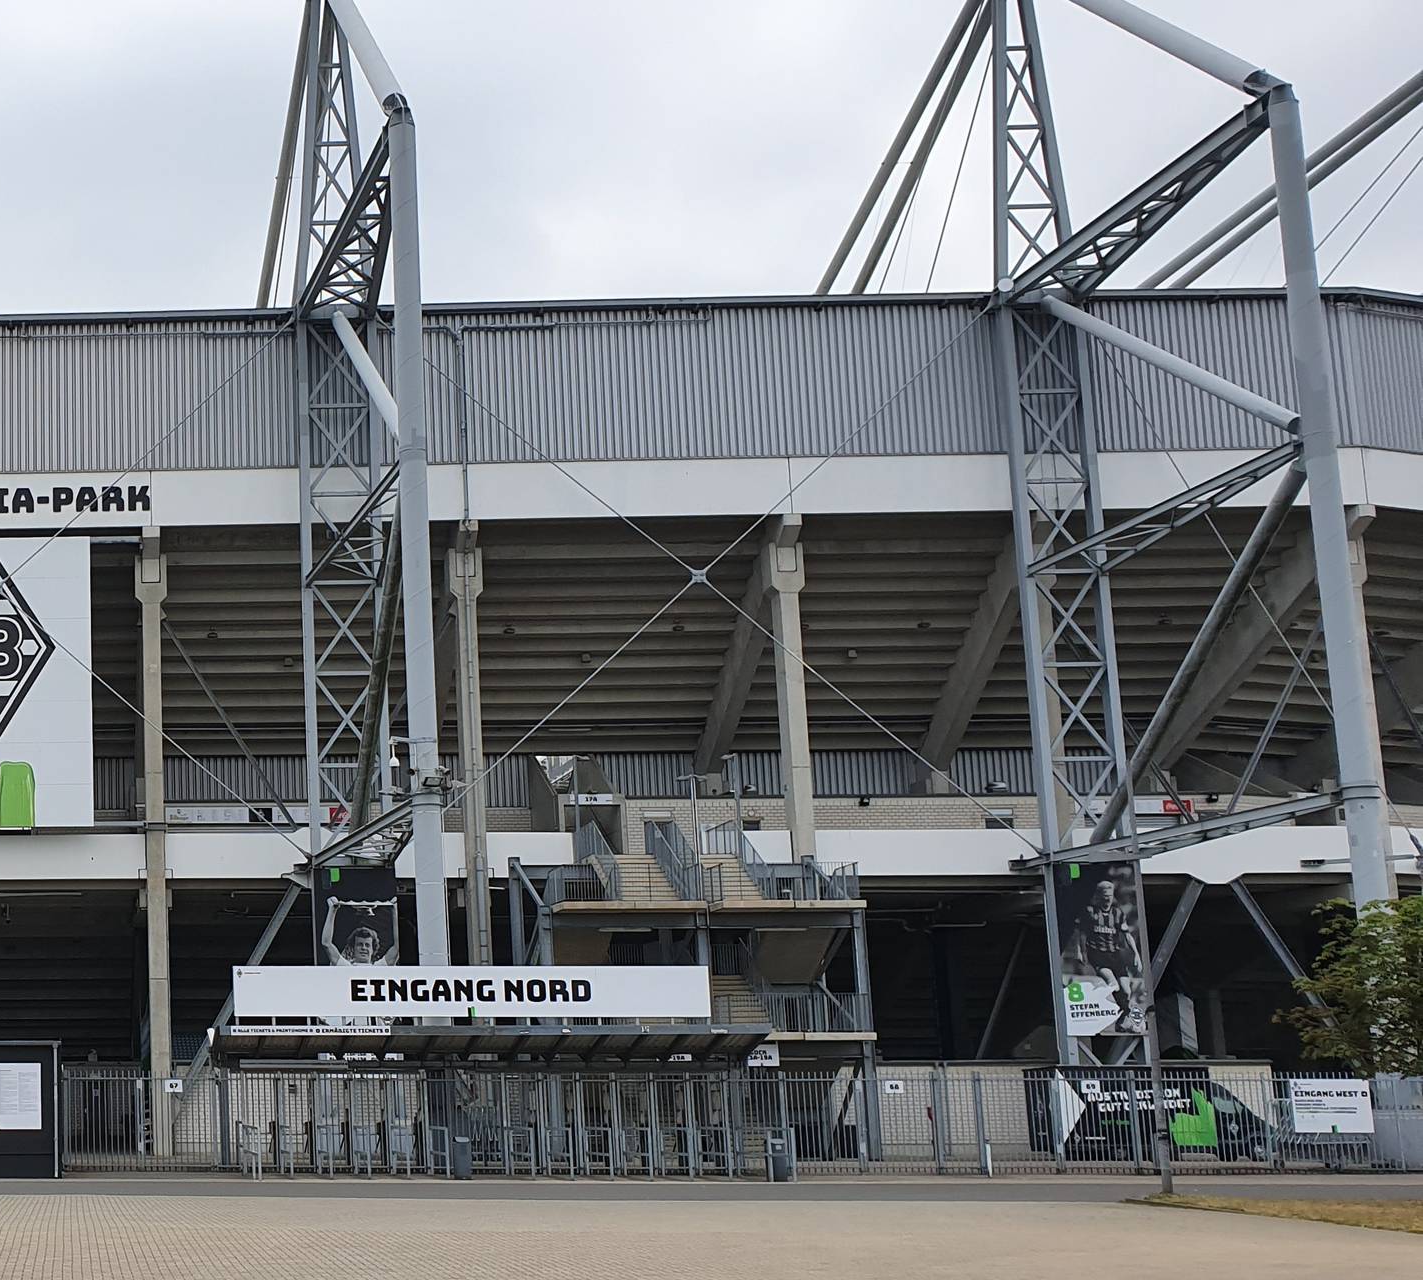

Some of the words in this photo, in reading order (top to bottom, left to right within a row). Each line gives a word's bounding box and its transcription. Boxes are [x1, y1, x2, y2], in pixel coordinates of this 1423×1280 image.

[350, 979, 496, 1003] EINGANG
[503, 979, 592, 1003] NORD
[1067, 982, 1085, 1002] 8
[1070, 1003, 1099, 1011] STEFAN
[1071, 1009, 1117, 1018] EFFENBERG
[1294, 1090, 1334, 1098] EINGANG
[1335, 1090, 1359, 1098] WEST
